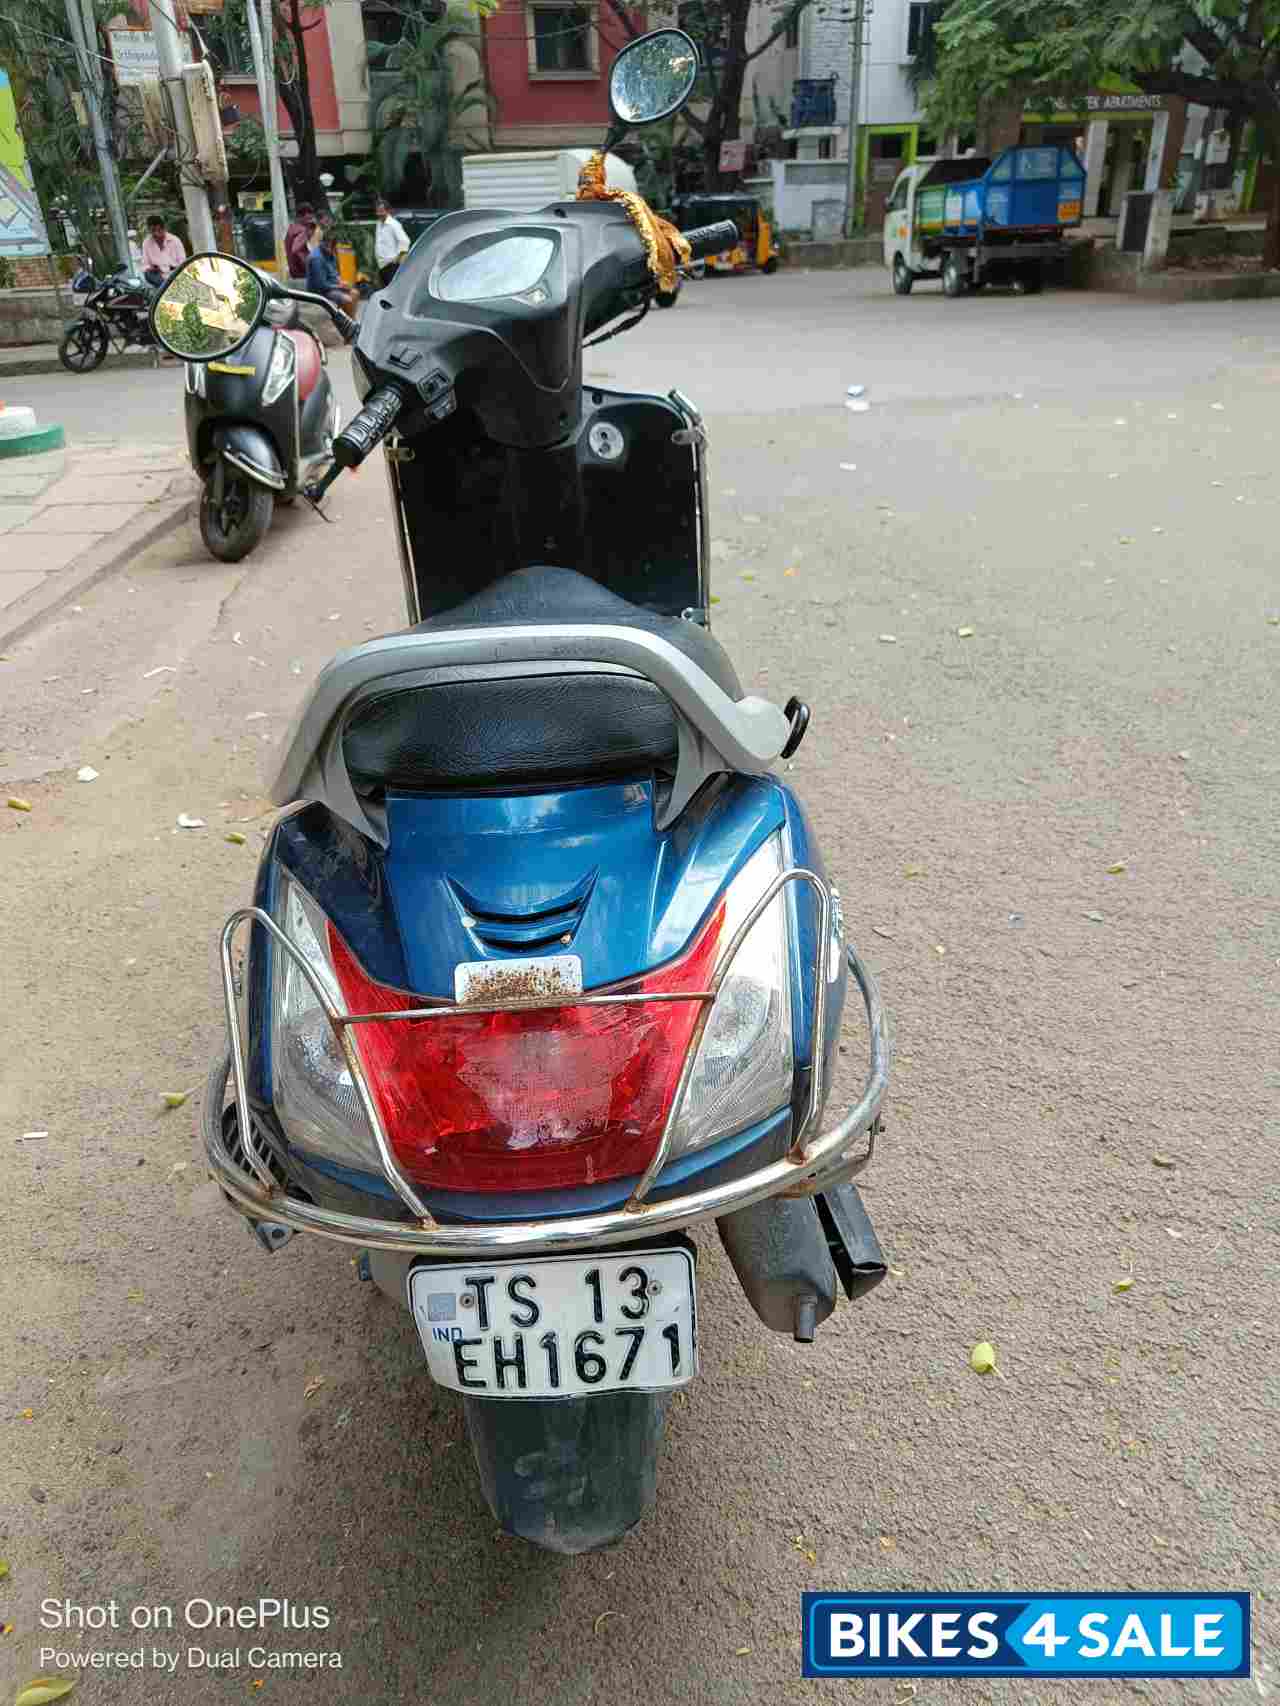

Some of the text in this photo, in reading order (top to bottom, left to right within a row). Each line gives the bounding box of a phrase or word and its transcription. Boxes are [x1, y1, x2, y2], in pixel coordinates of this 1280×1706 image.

[464, 1266, 650, 1331] TS 13
[432, 1327, 464, 1342] IND
[454, 1323, 680, 1388] EH1671
